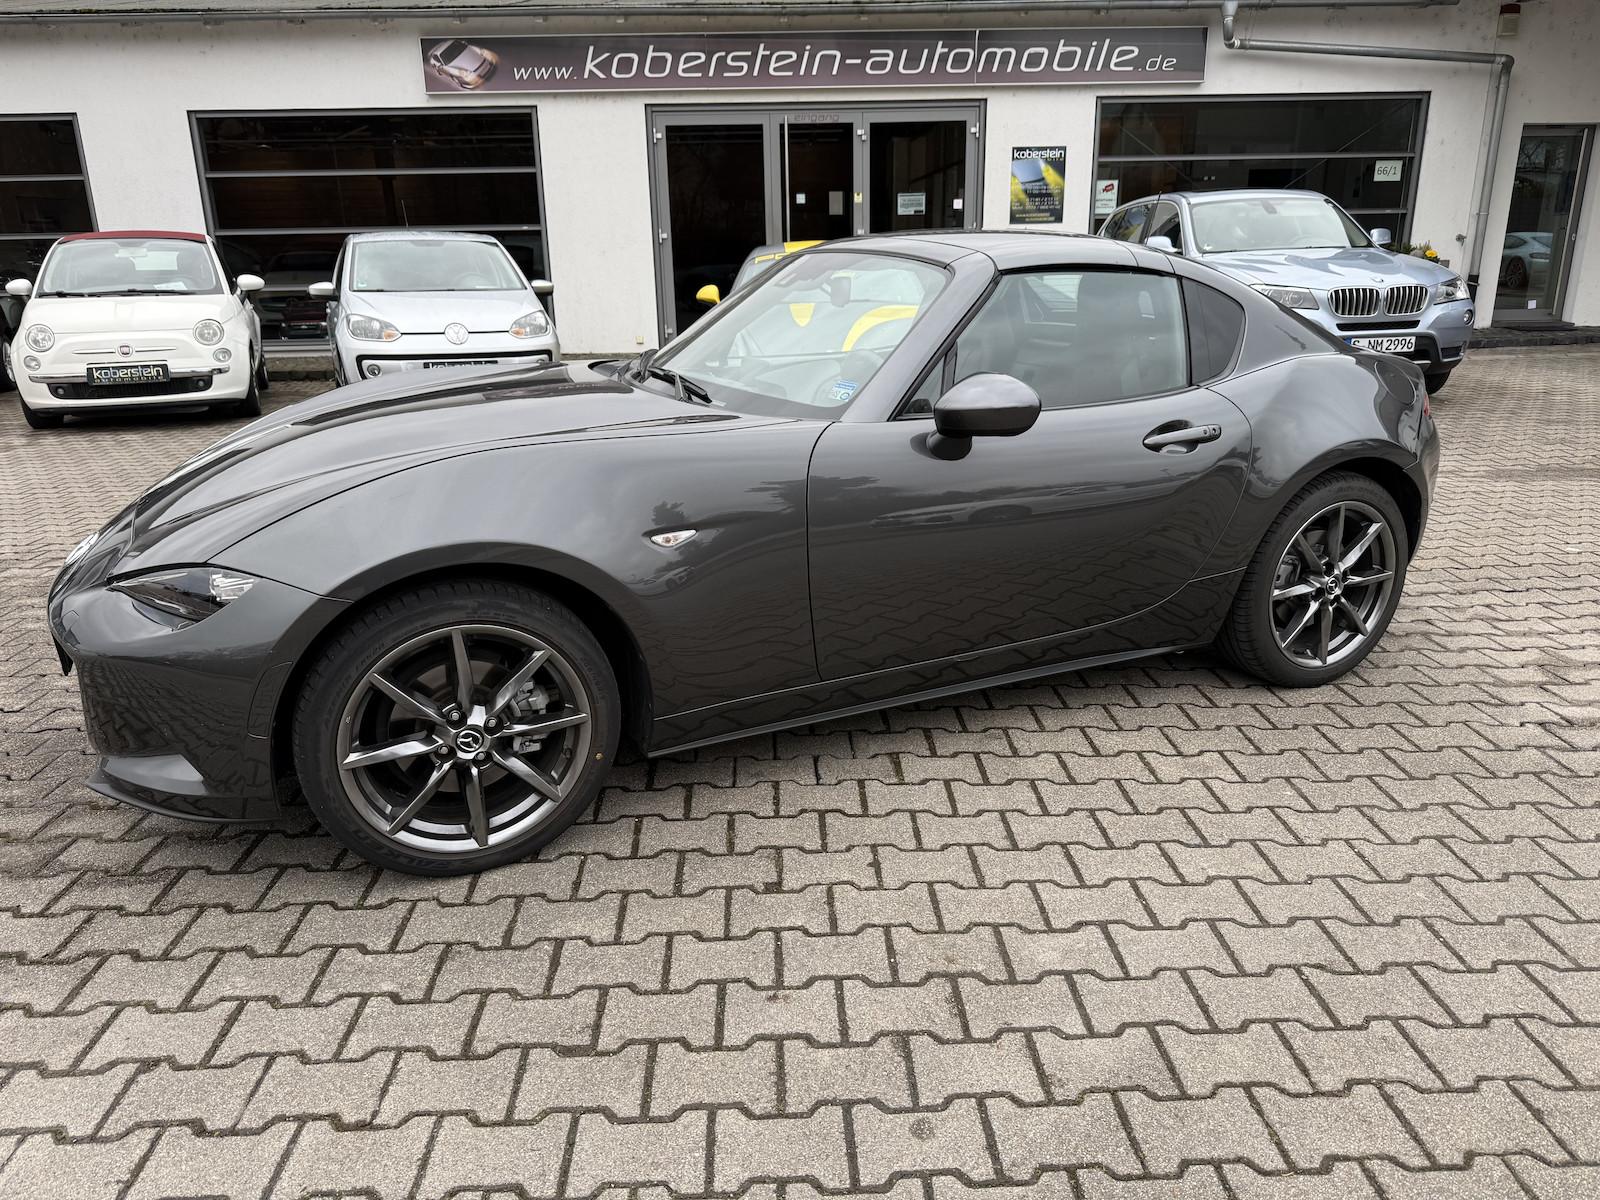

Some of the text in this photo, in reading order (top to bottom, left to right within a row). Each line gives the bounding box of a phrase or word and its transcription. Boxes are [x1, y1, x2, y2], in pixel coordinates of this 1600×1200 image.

[513, 38, 1177, 81] www.koberstein-automobile.de
[793, 112, 840, 123] eingang
[1013, 149, 1065, 159] koberstein
[1376, 166, 1398, 177] 66/1
[1385, 338, 1414, 351] 2996
[92, 365, 164, 379] koberstein
